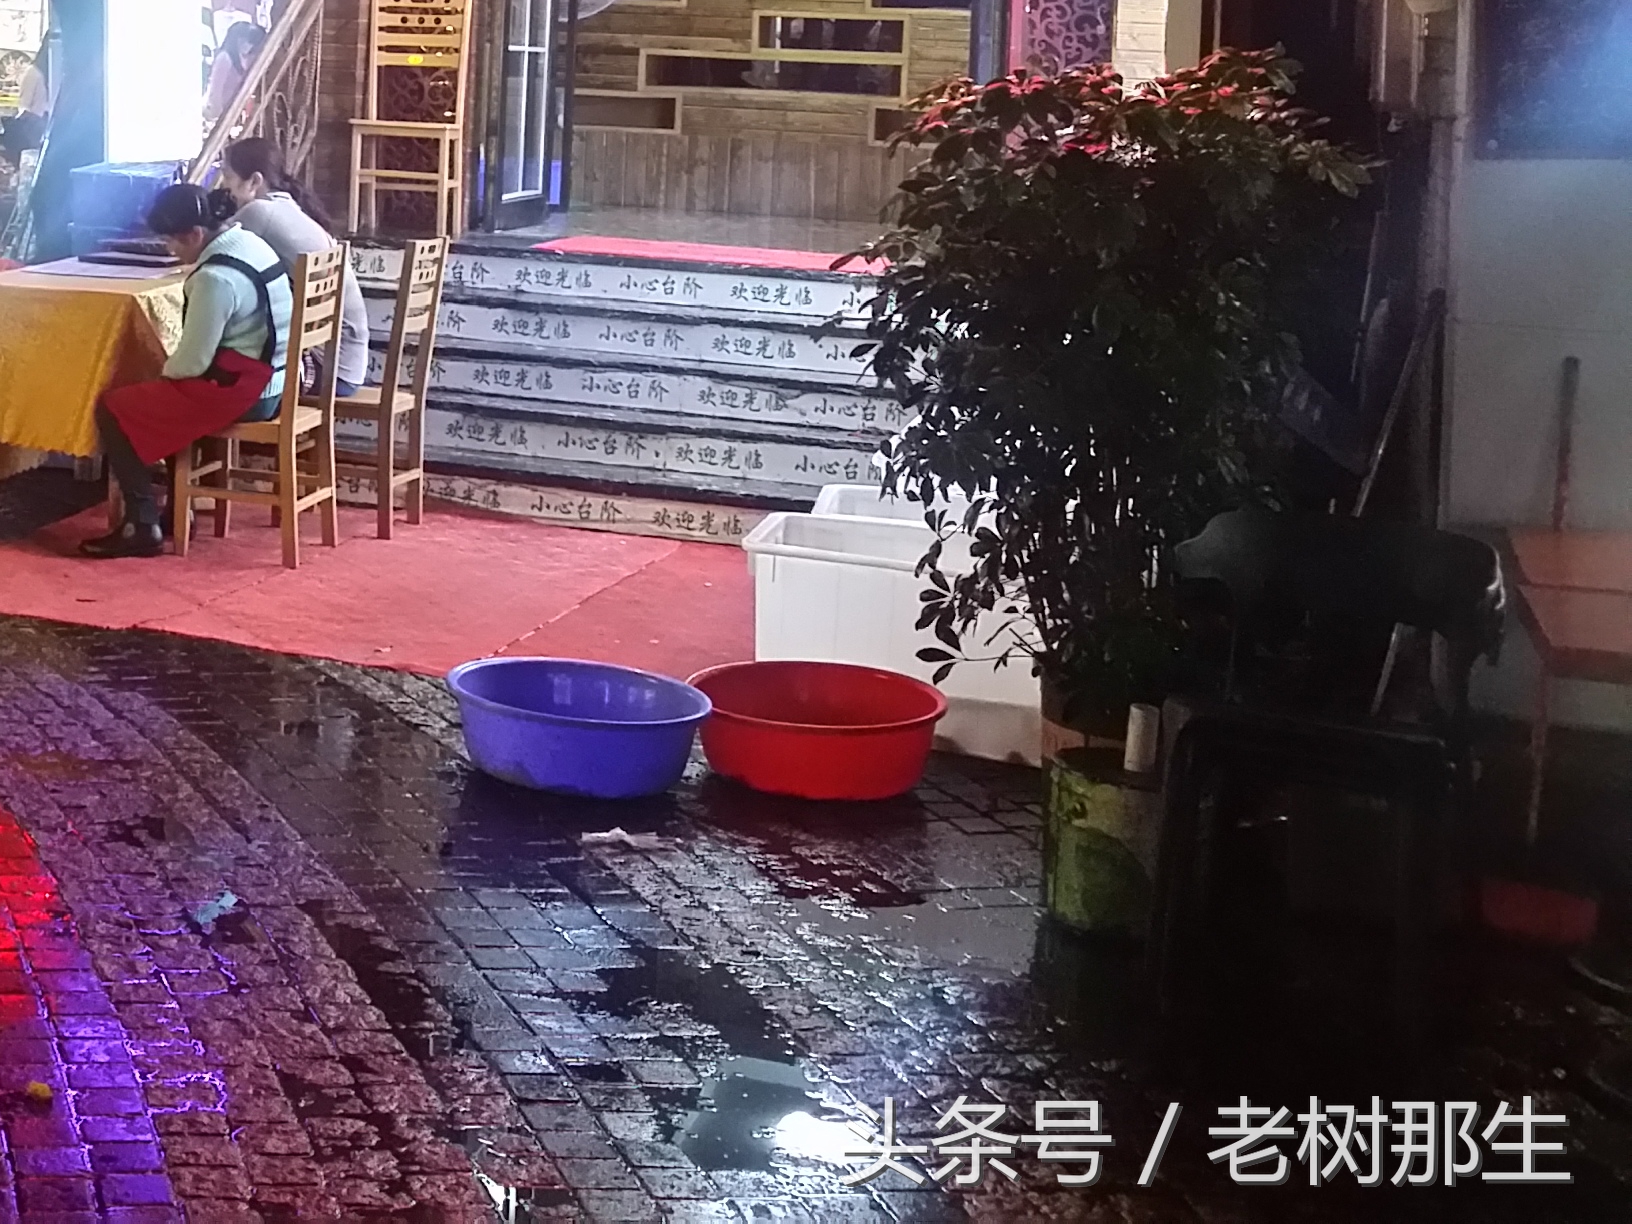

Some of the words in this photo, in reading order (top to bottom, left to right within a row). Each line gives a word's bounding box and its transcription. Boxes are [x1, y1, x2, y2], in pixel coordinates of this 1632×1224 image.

[515, 268, 592, 289] 欢迎光临
[619, 275, 704, 299] 小心台阶
[730, 282, 814, 306] 欢迎光临
[492, 316, 571, 340] 欢迎光临
[598, 325, 685, 350] 小心台阶
[711, 333, 797, 359] 欢迎光临
[472, 366, 554, 391] 欢迎光临
[580, 376, 670, 402] 小心台阶
[697, 388, 787, 412] 欢迎光临
[813, 398, 907, 426] 小心台阶
[445, 420, 528, 450] 欢迎光临
[557, 433, 647, 460] 小心台阶
[675, 443, 764, 470] 欢迎光临
[530, 495, 623, 524] 小心台阶
[652, 508, 744, 536] 欢迎光临
